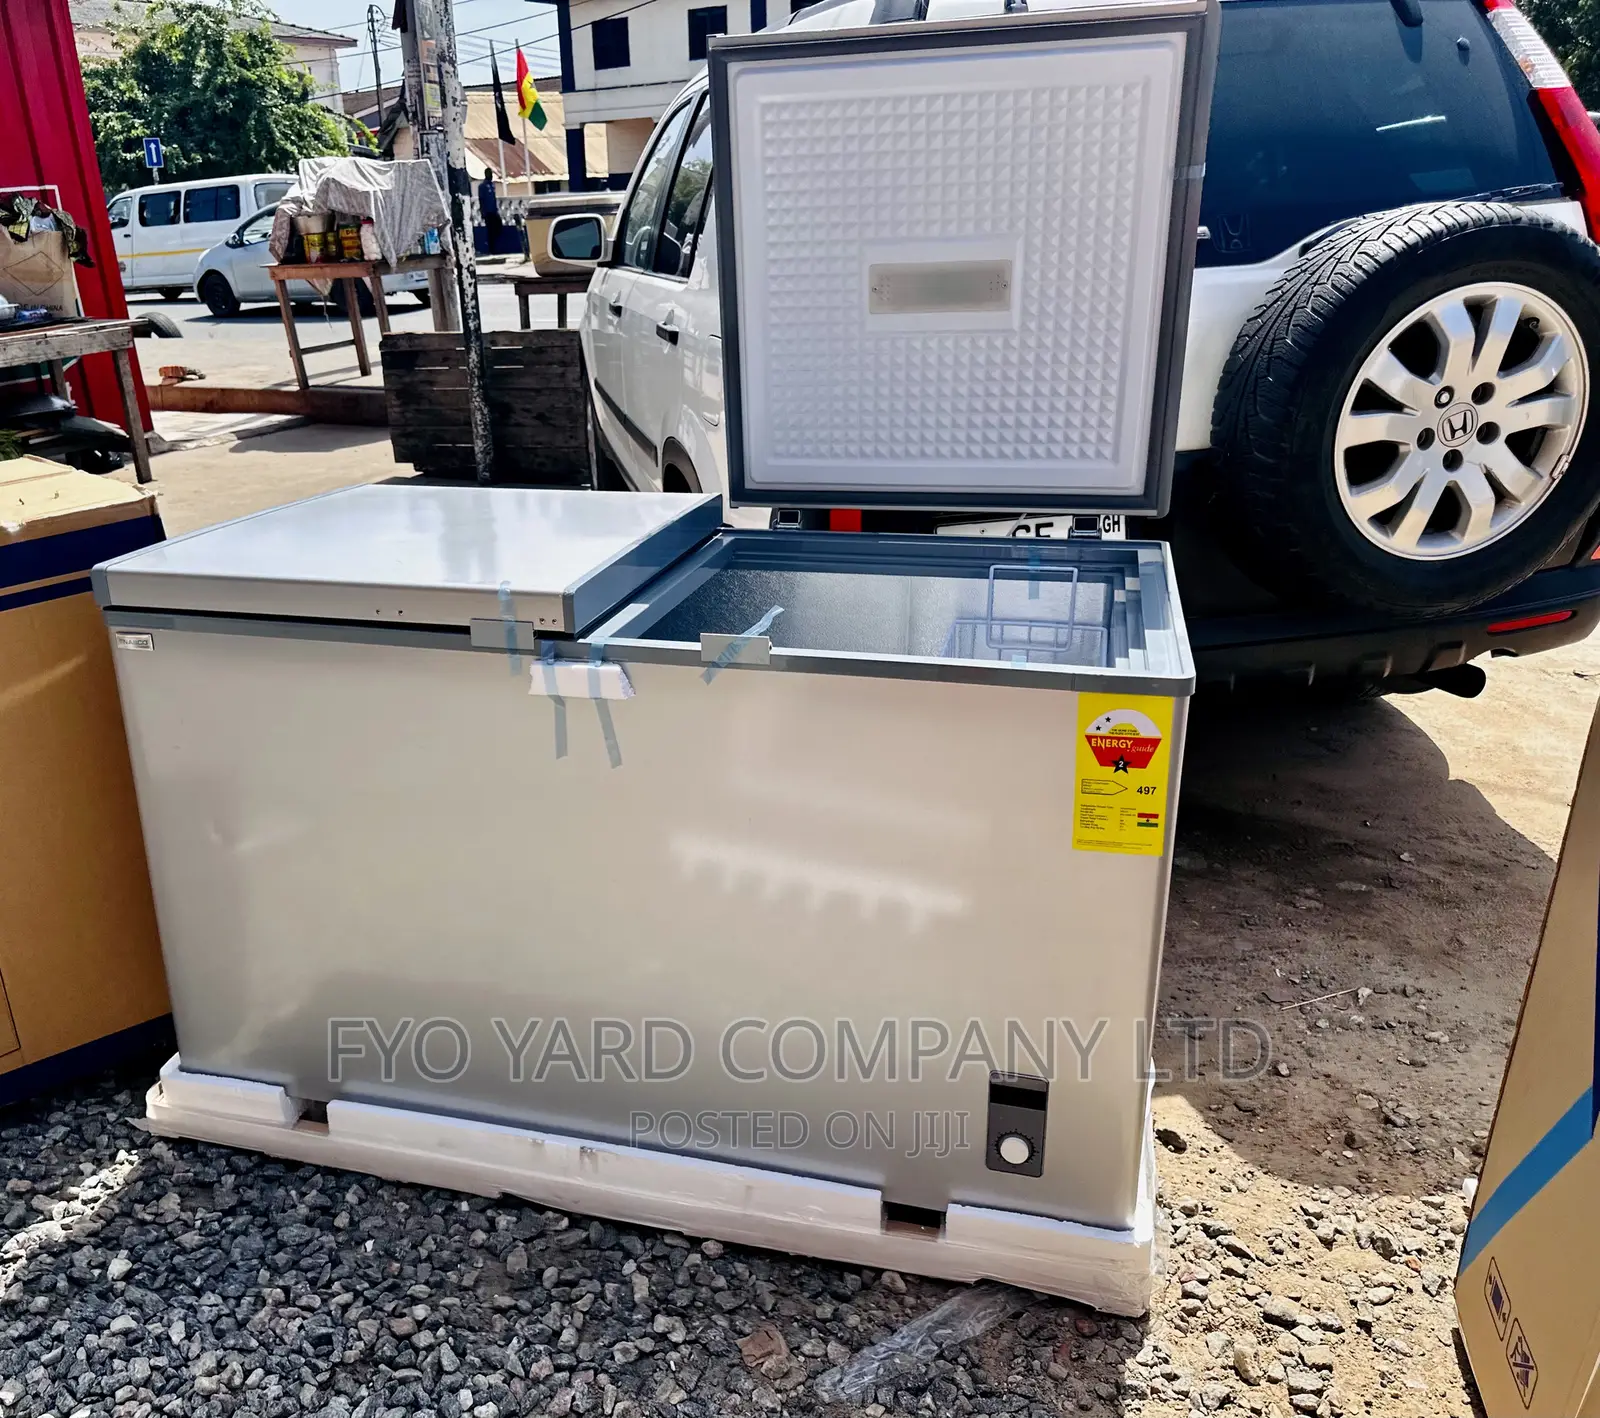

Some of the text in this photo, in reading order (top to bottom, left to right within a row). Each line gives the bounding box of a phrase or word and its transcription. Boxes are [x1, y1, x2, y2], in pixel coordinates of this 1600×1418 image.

[1102, 514, 1121, 533] GH
[1091, 736, 1134, 750] ENERGY
[1118, 760, 1124, 768] 2
[1136, 785, 1157, 795] 497
